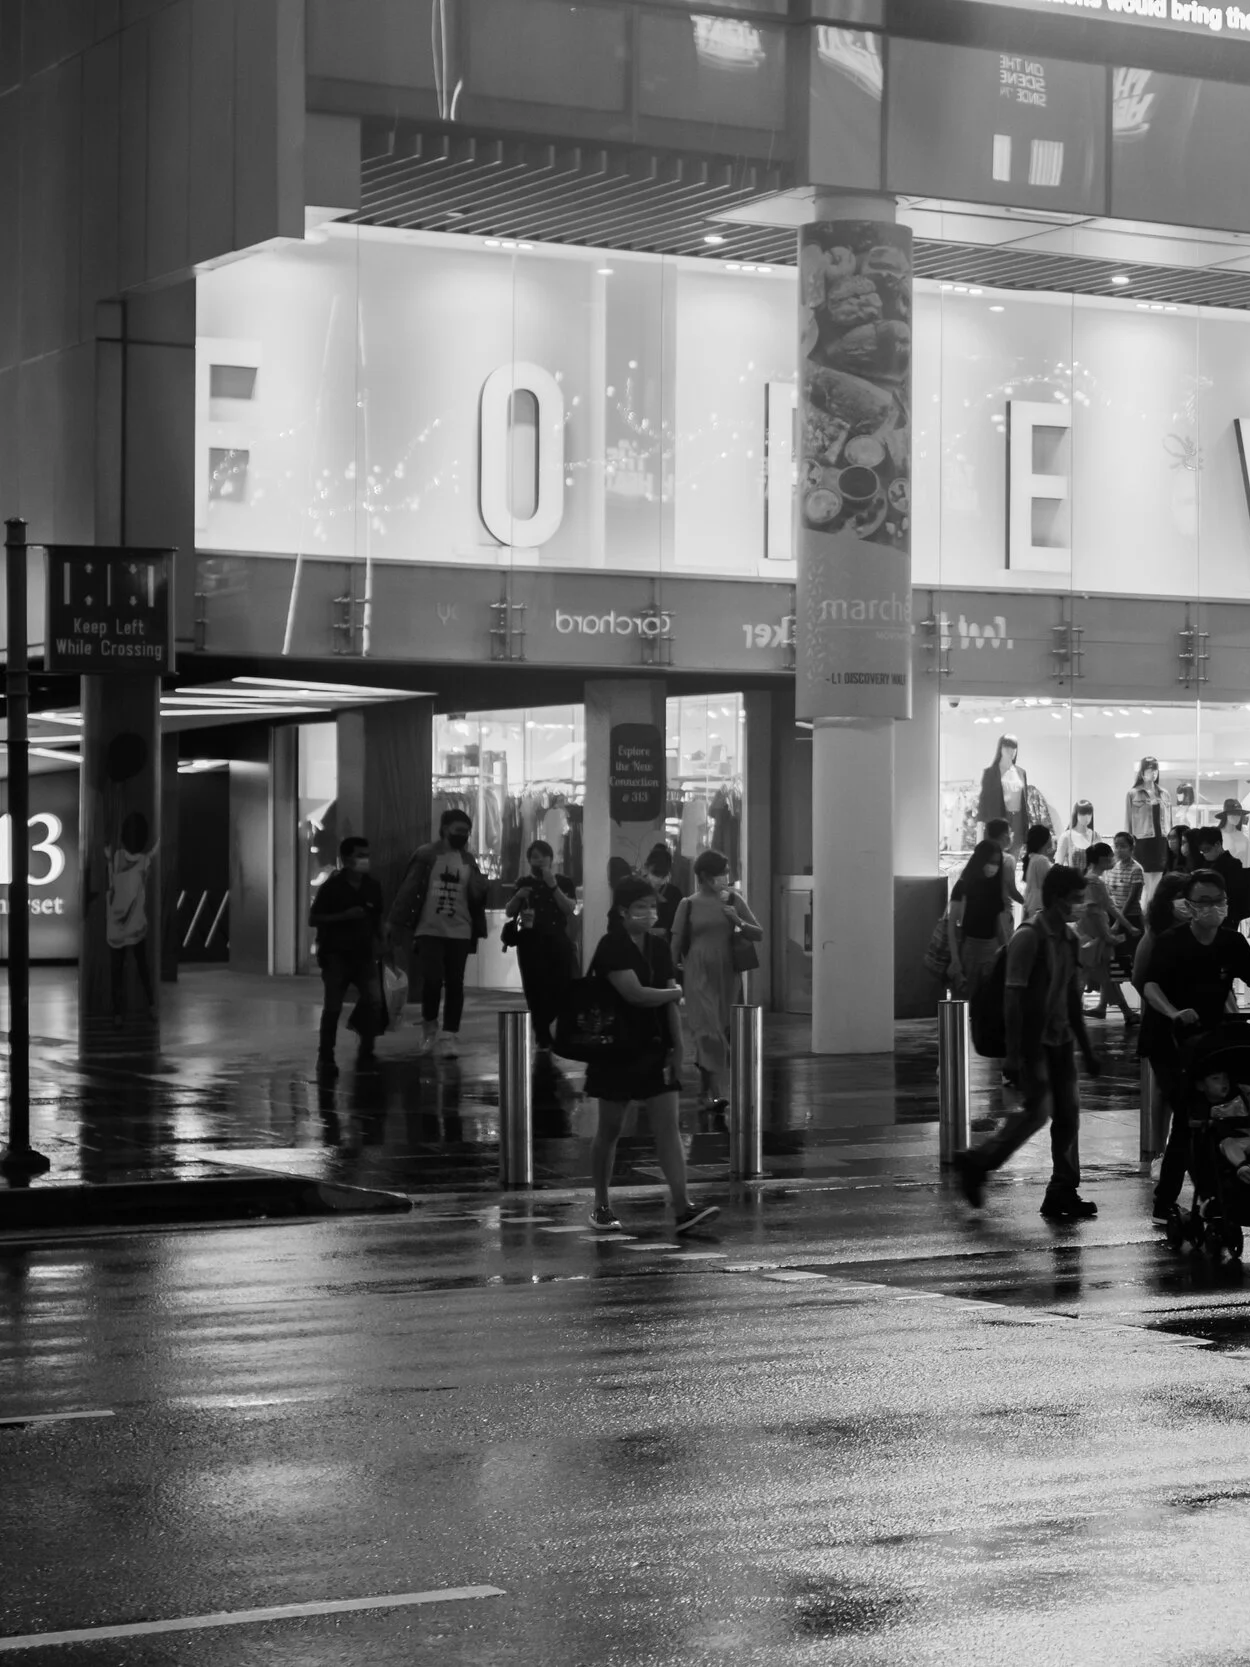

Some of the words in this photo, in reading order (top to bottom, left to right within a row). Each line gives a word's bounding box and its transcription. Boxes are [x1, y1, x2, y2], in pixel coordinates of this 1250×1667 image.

[1171, 1, 1222, 31] bring
[73, 618, 107, 638] Keep
[116, 619, 145, 636] Left
[56, 639, 92, 655] While
[101, 640, 162, 661] Crossing
[844, 672, 890, 685] DISCOVERY
